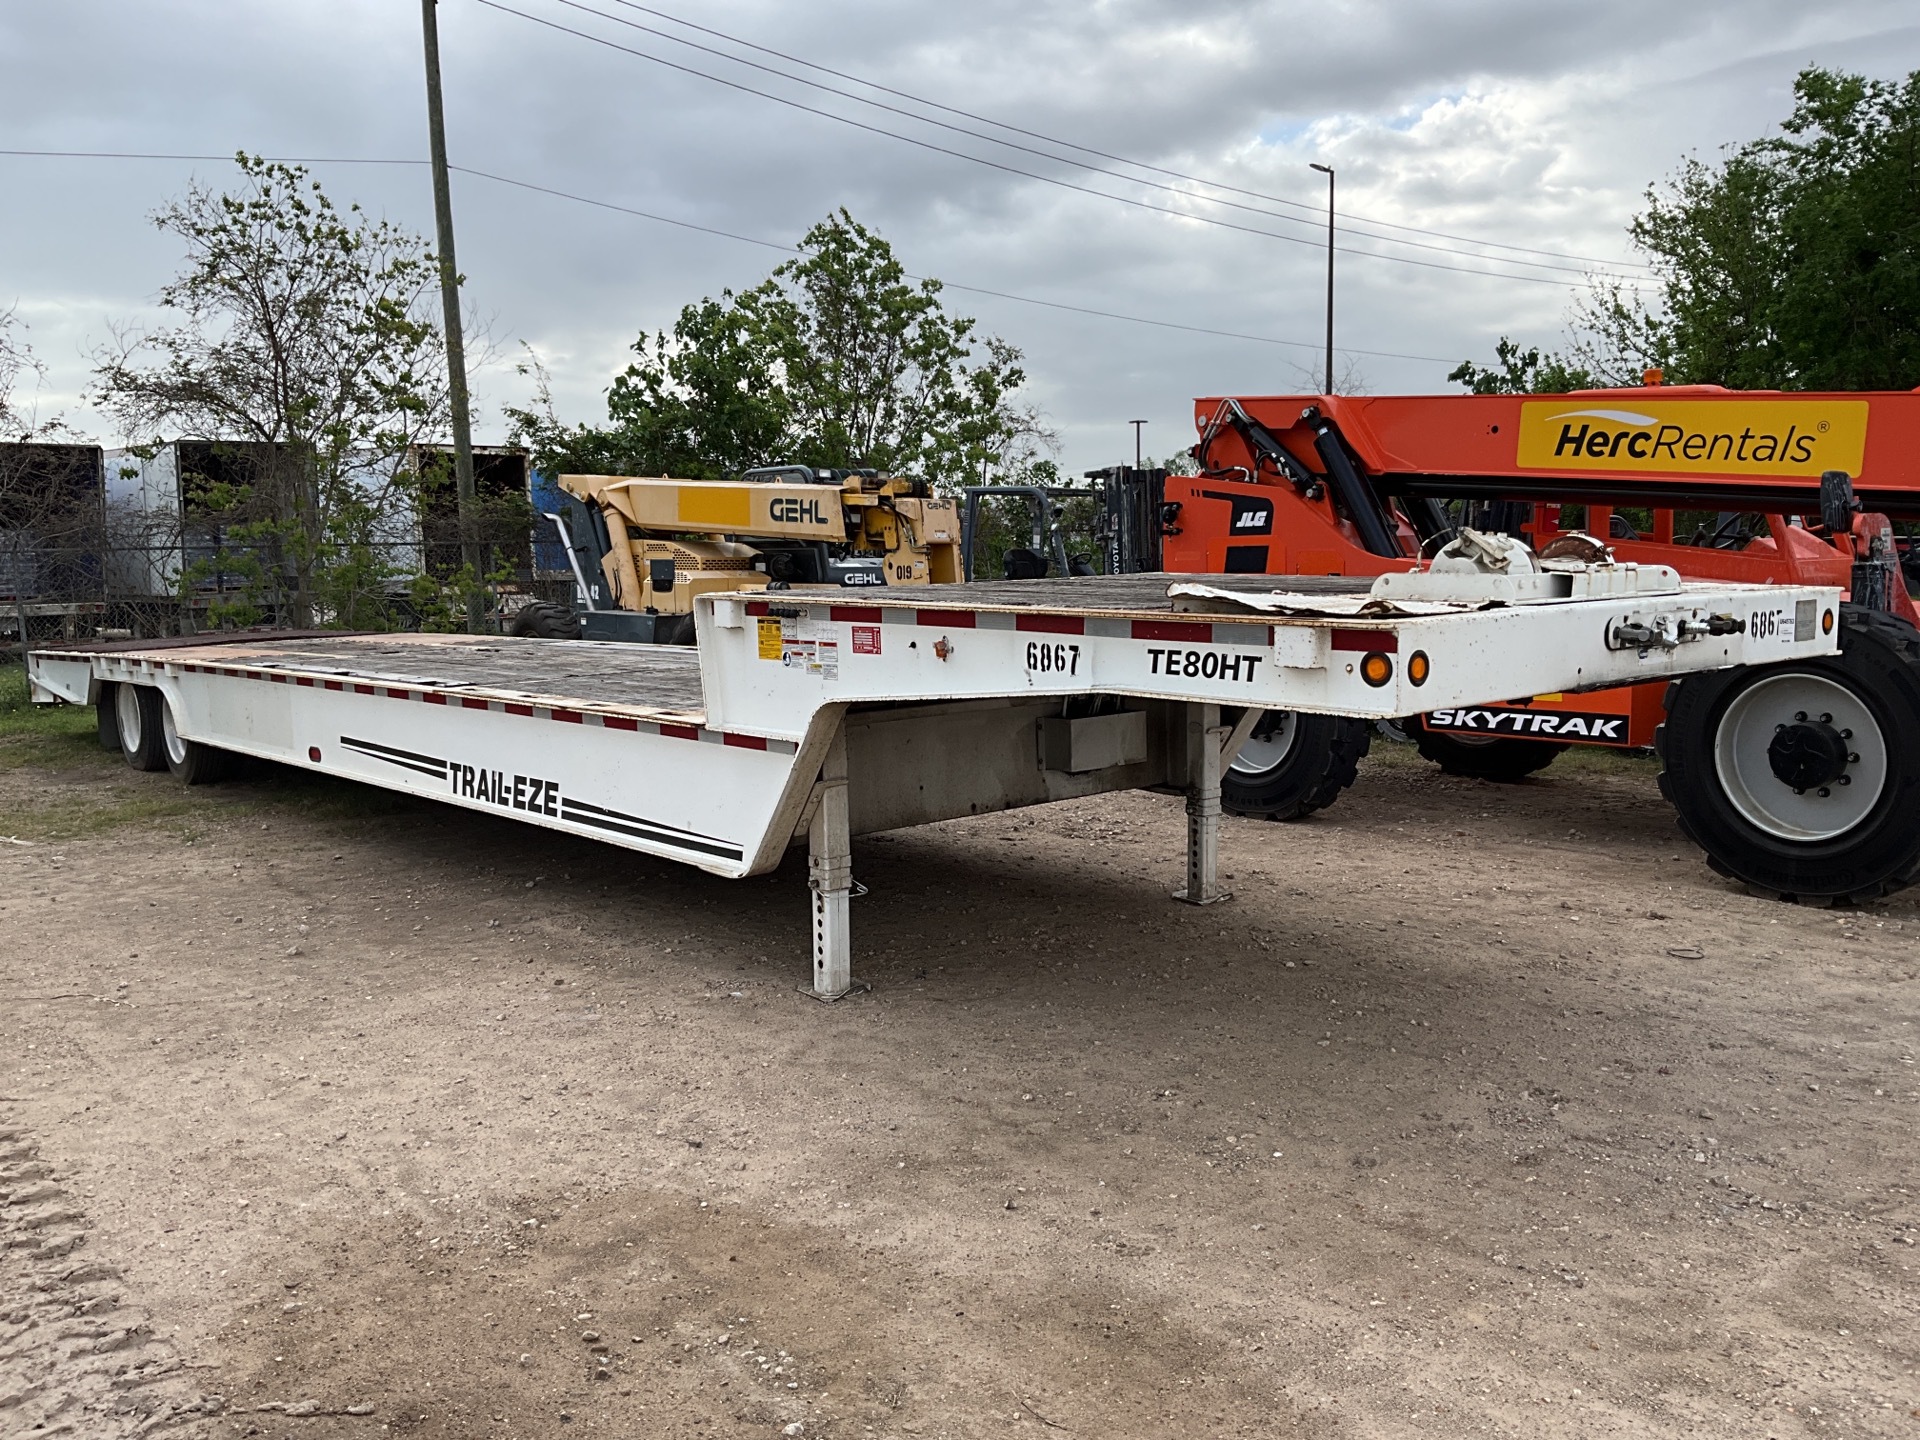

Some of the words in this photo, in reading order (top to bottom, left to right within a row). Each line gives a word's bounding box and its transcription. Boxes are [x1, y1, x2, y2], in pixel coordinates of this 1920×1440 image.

[1554, 424, 1817, 463] HercRentals
[769, 497, 829, 524] GEHL
[926, 502, 951, 510] GEHL
[1235, 511, 1267, 527] JLG
[896, 565, 912, 580] 019
[1112, 542, 1120, 575] OYOTA
[844, 573, 882, 585] GEHL
[1751, 610, 1783, 639] 6867
[1026, 641, 1081, 676] 6867
[1147, 648, 1263, 682] TE80HT
[1430, 709, 1624, 738] SKYTRAK
[449, 761, 560, 818] TRAIL-EZE
